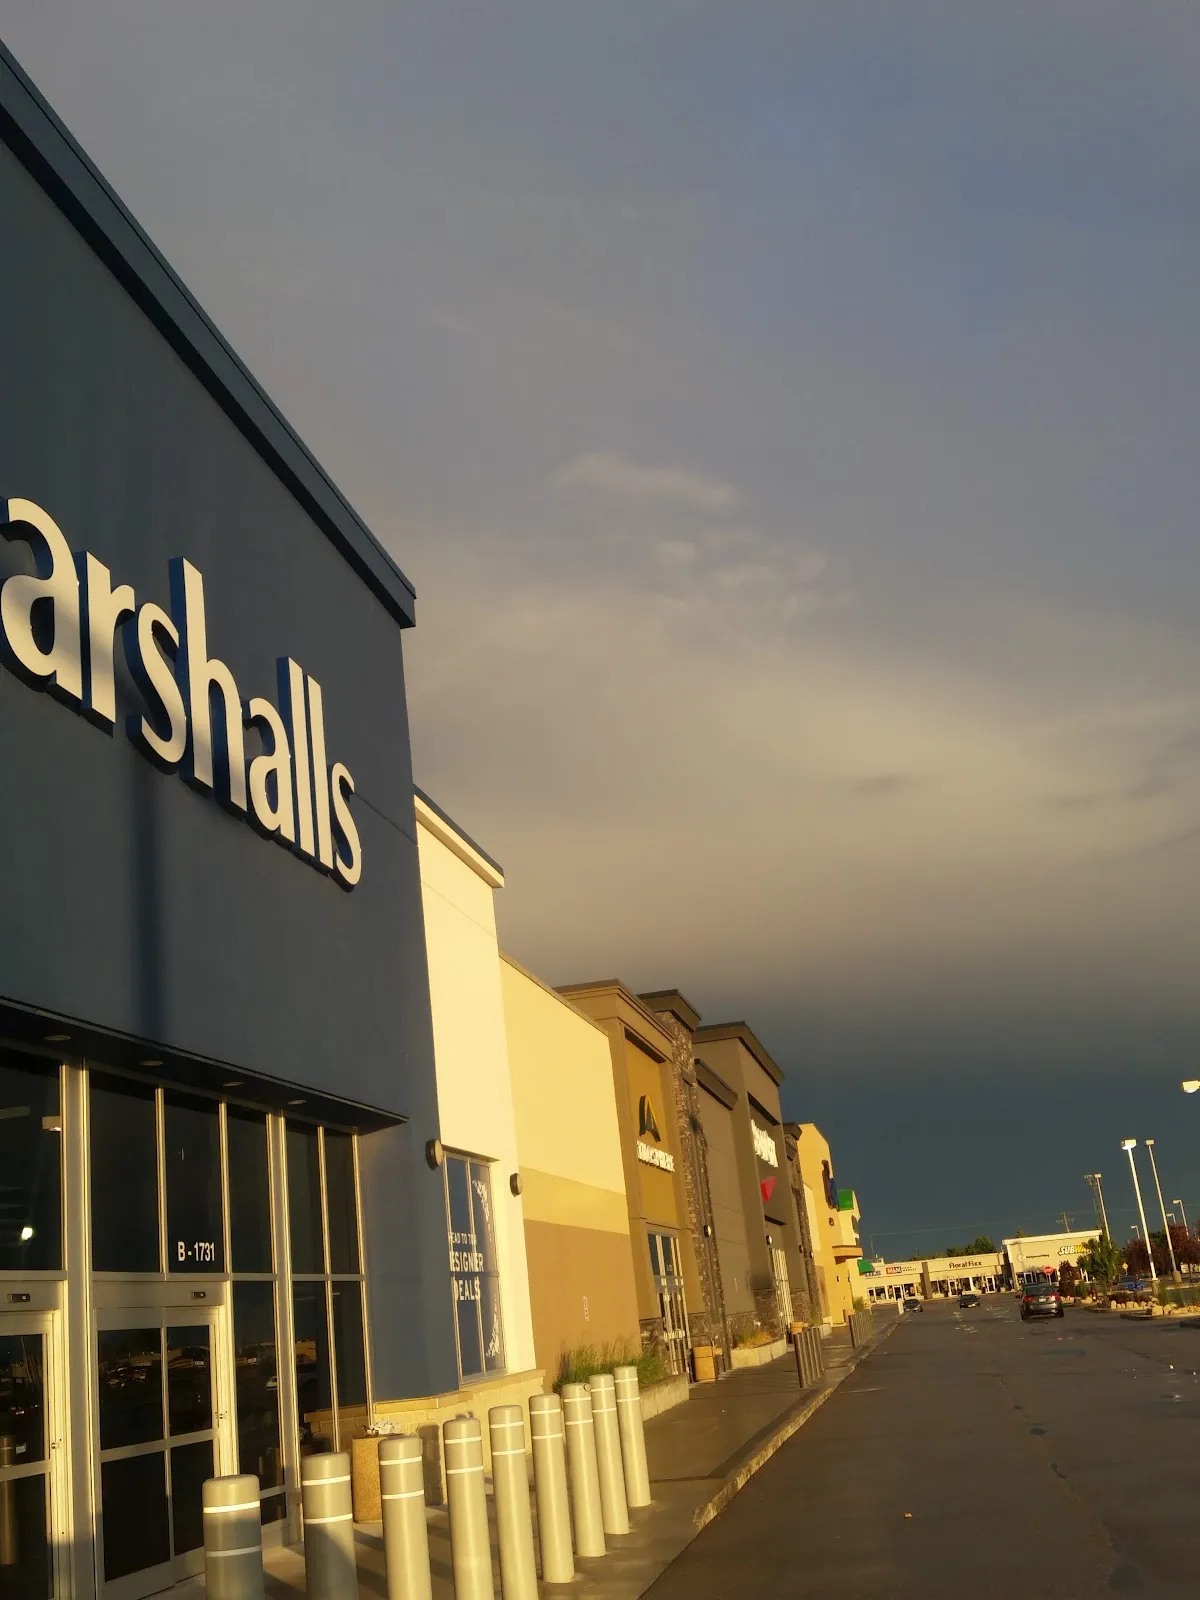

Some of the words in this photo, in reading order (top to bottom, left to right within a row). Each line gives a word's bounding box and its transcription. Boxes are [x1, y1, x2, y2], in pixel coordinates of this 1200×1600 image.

[178, 1241, 186, 1262] B
[194, 1242, 215, 1262] 1731
[1058, 1245, 1089, 1256] SUBWA
